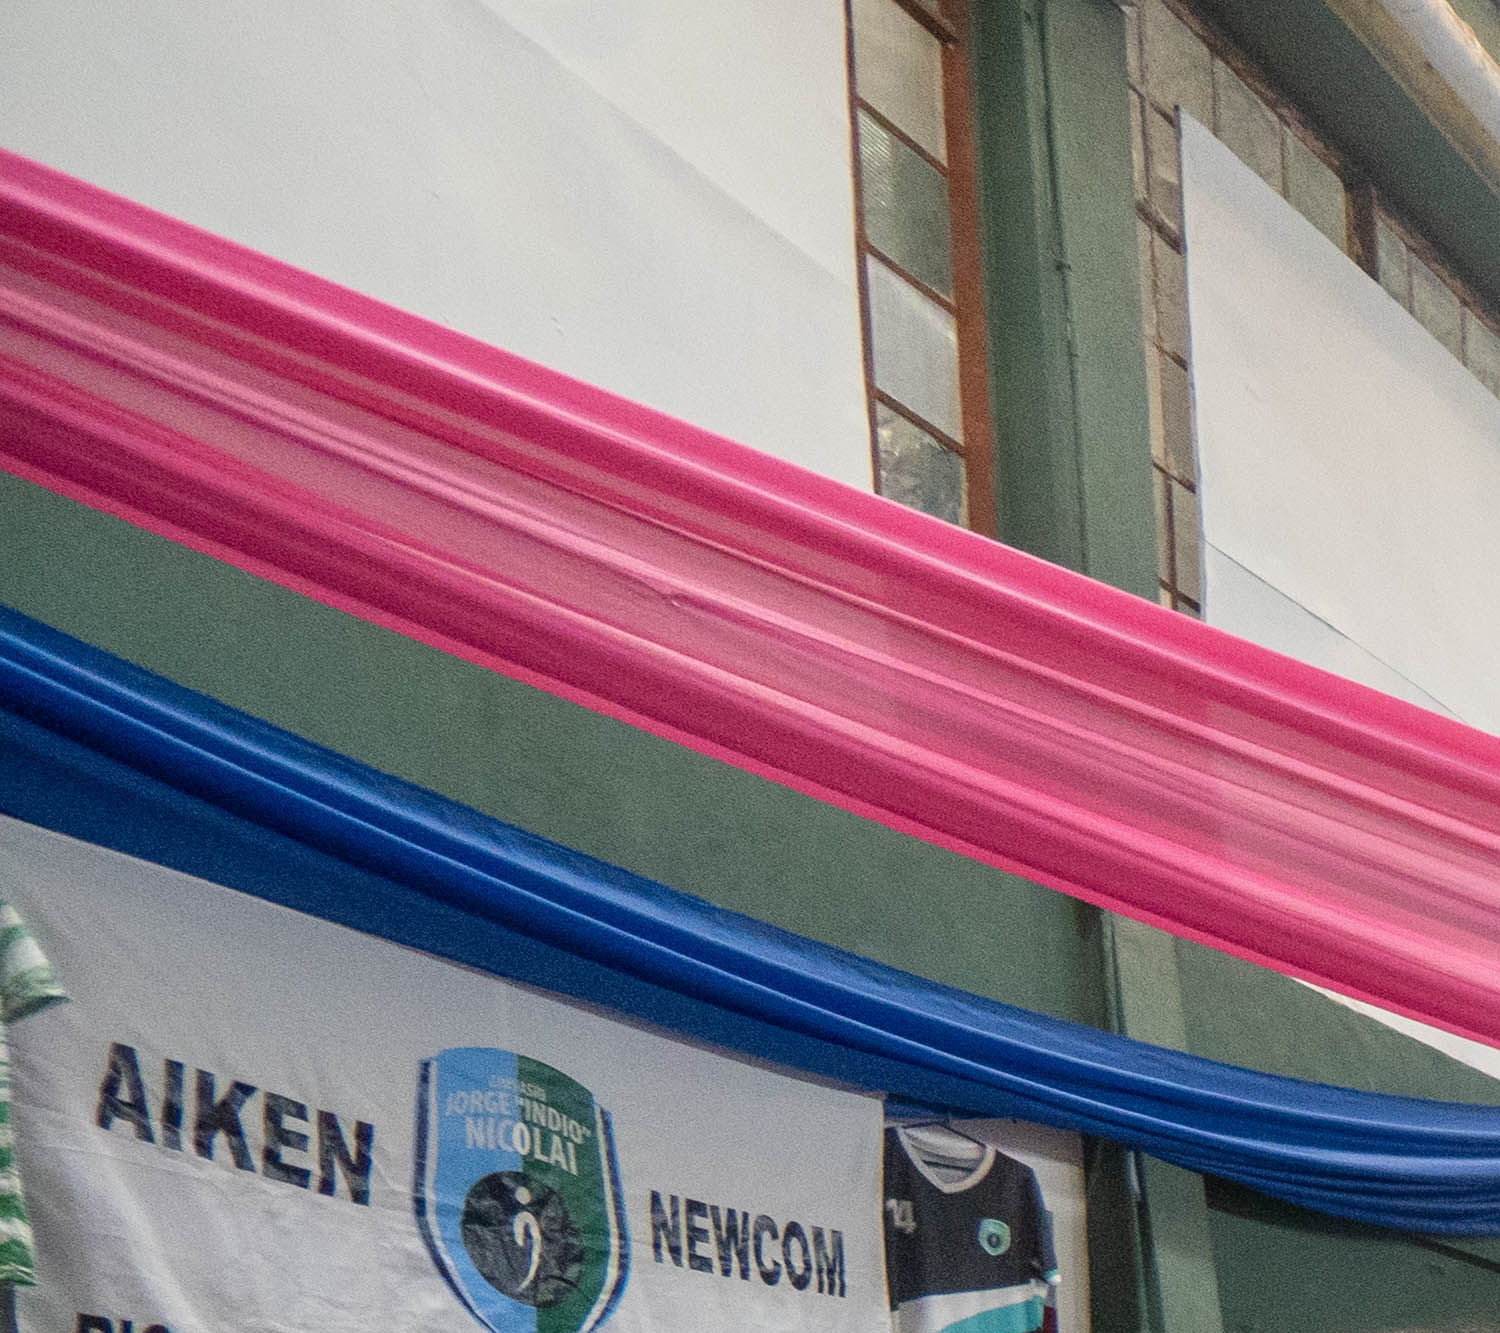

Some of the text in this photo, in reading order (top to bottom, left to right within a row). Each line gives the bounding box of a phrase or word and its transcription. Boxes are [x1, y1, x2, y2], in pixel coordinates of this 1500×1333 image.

[96, 1042, 374, 1206] AIKEN
[445, 1090, 513, 1117] JORGE
[464, 1116, 578, 1176] NICOLAI
[649, 1190, 847, 1298] NEWCOM
